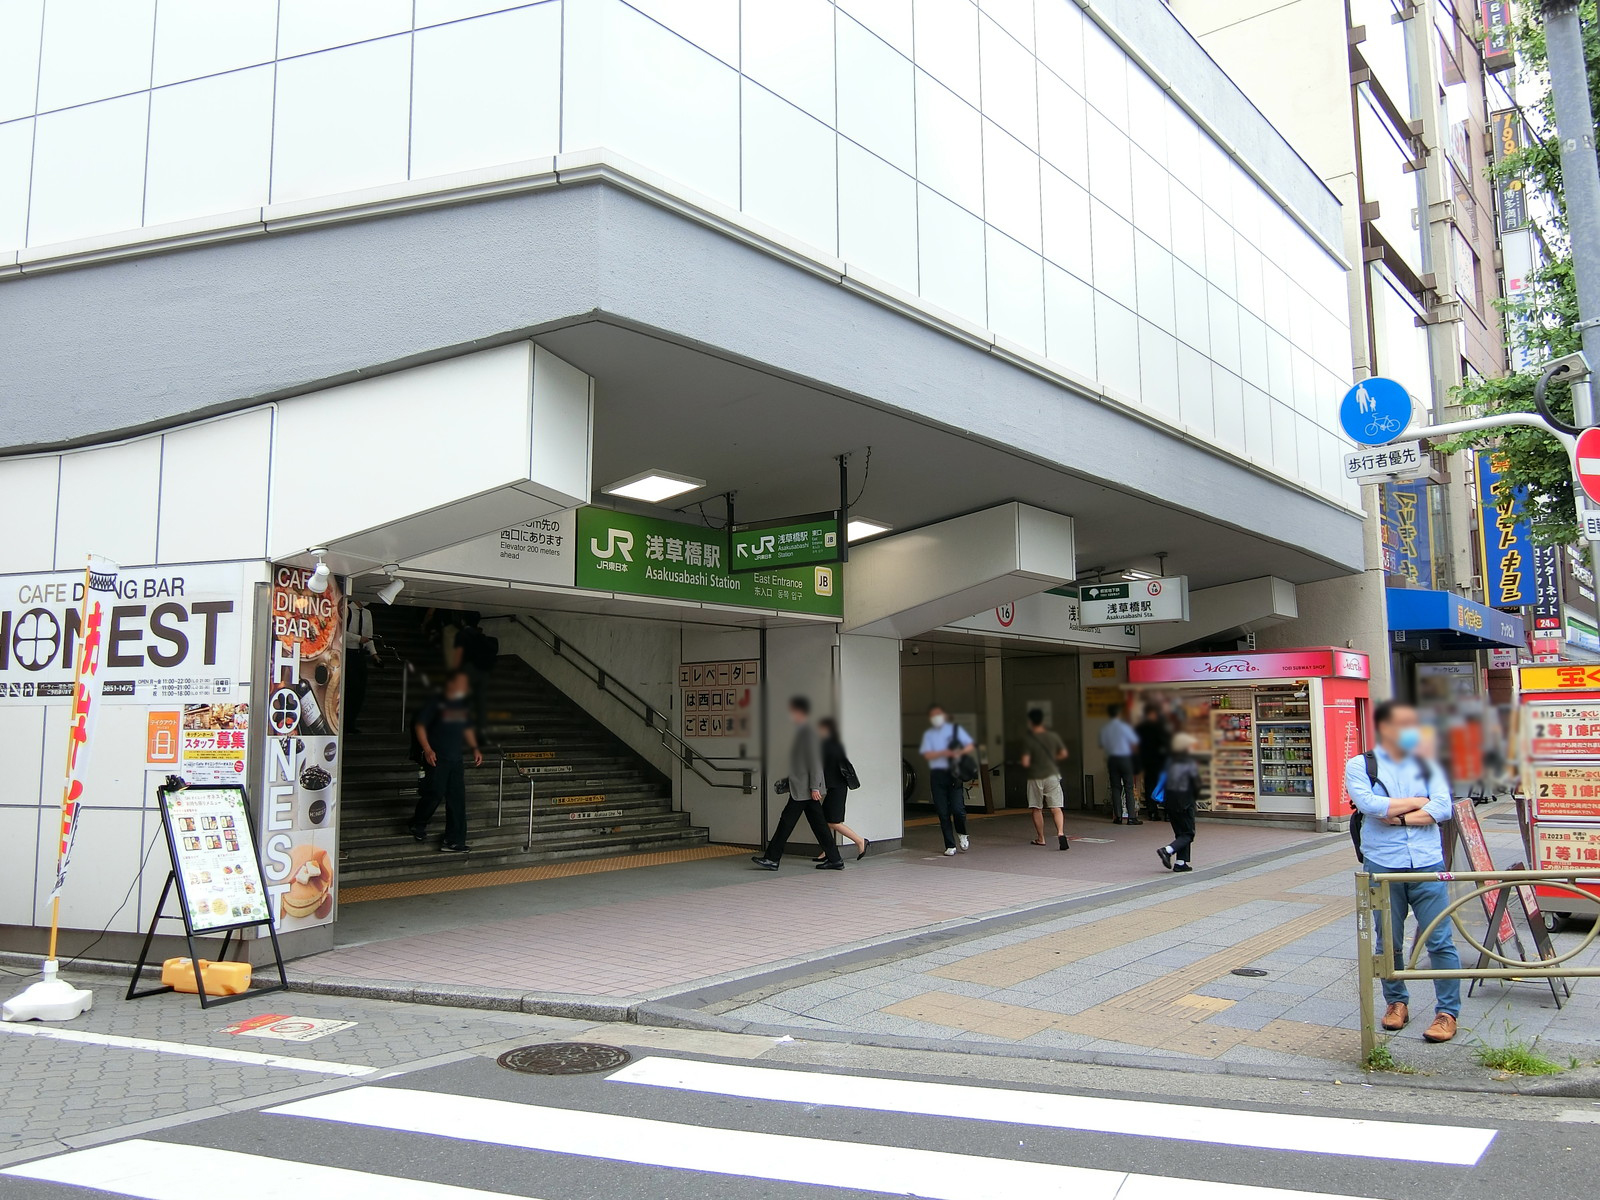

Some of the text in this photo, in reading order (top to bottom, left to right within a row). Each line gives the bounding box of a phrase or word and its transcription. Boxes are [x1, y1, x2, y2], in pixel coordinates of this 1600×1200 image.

[1349, 448, 1416, 473] 歩行者優先
[500, 529, 564, 547] 西口にあります
[590, 528, 634, 562] JR
[751, 535, 775, 555] JR
[777, 531, 809, 544] 浅草橋駅
[500, 541, 560, 556] Elevator 200 meters
[645, 534, 721, 569] 浅草橋駅
[777, 543, 810, 552] Asakusabashi
[777, 551, 794, 559] Station
[499, 551, 520, 560] ahead
[596, 560, 629, 572] JR東日本
[278, 567, 312, 590] CAF
[645, 565, 741, 590] Asakusabashi Station
[754, 573, 803, 589] East Entrance
[819, 575, 829, 587] JB
[1542, 546, 1557, 616] インターネット
[19, 583, 68, 604] CAFE
[144, 577, 185, 598] BAR
[754, 586, 773, 597] 东入口
[777, 589, 803, 601] 동쪽 입구
[276, 591, 332, 618] DINING
[1107, 601, 1152, 614] 浅草橋駅
[1001, 606, 1010, 619] 16
[1106, 612, 1143, 621] Asakusabashi
[275, 615, 311, 639] BAR
[1540, 618, 1555, 628] 24h
[0, 601, 234, 672] ONEST
[1543, 630, 1553, 638] 4F
[681, 665, 756, 682] エレベーター
[686, 692, 735, 707] は西口に
[1532, 710, 1563, 719] 513回
[185, 738, 216, 749] スタッフ
[217, 731, 246, 749] 募集
[1536, 770, 1567, 778] 444回
[1540, 783, 1567, 798] 2等
[1540, 832, 1571, 841] 第2023回
[1546, 845, 1600, 861] 1等 1億
